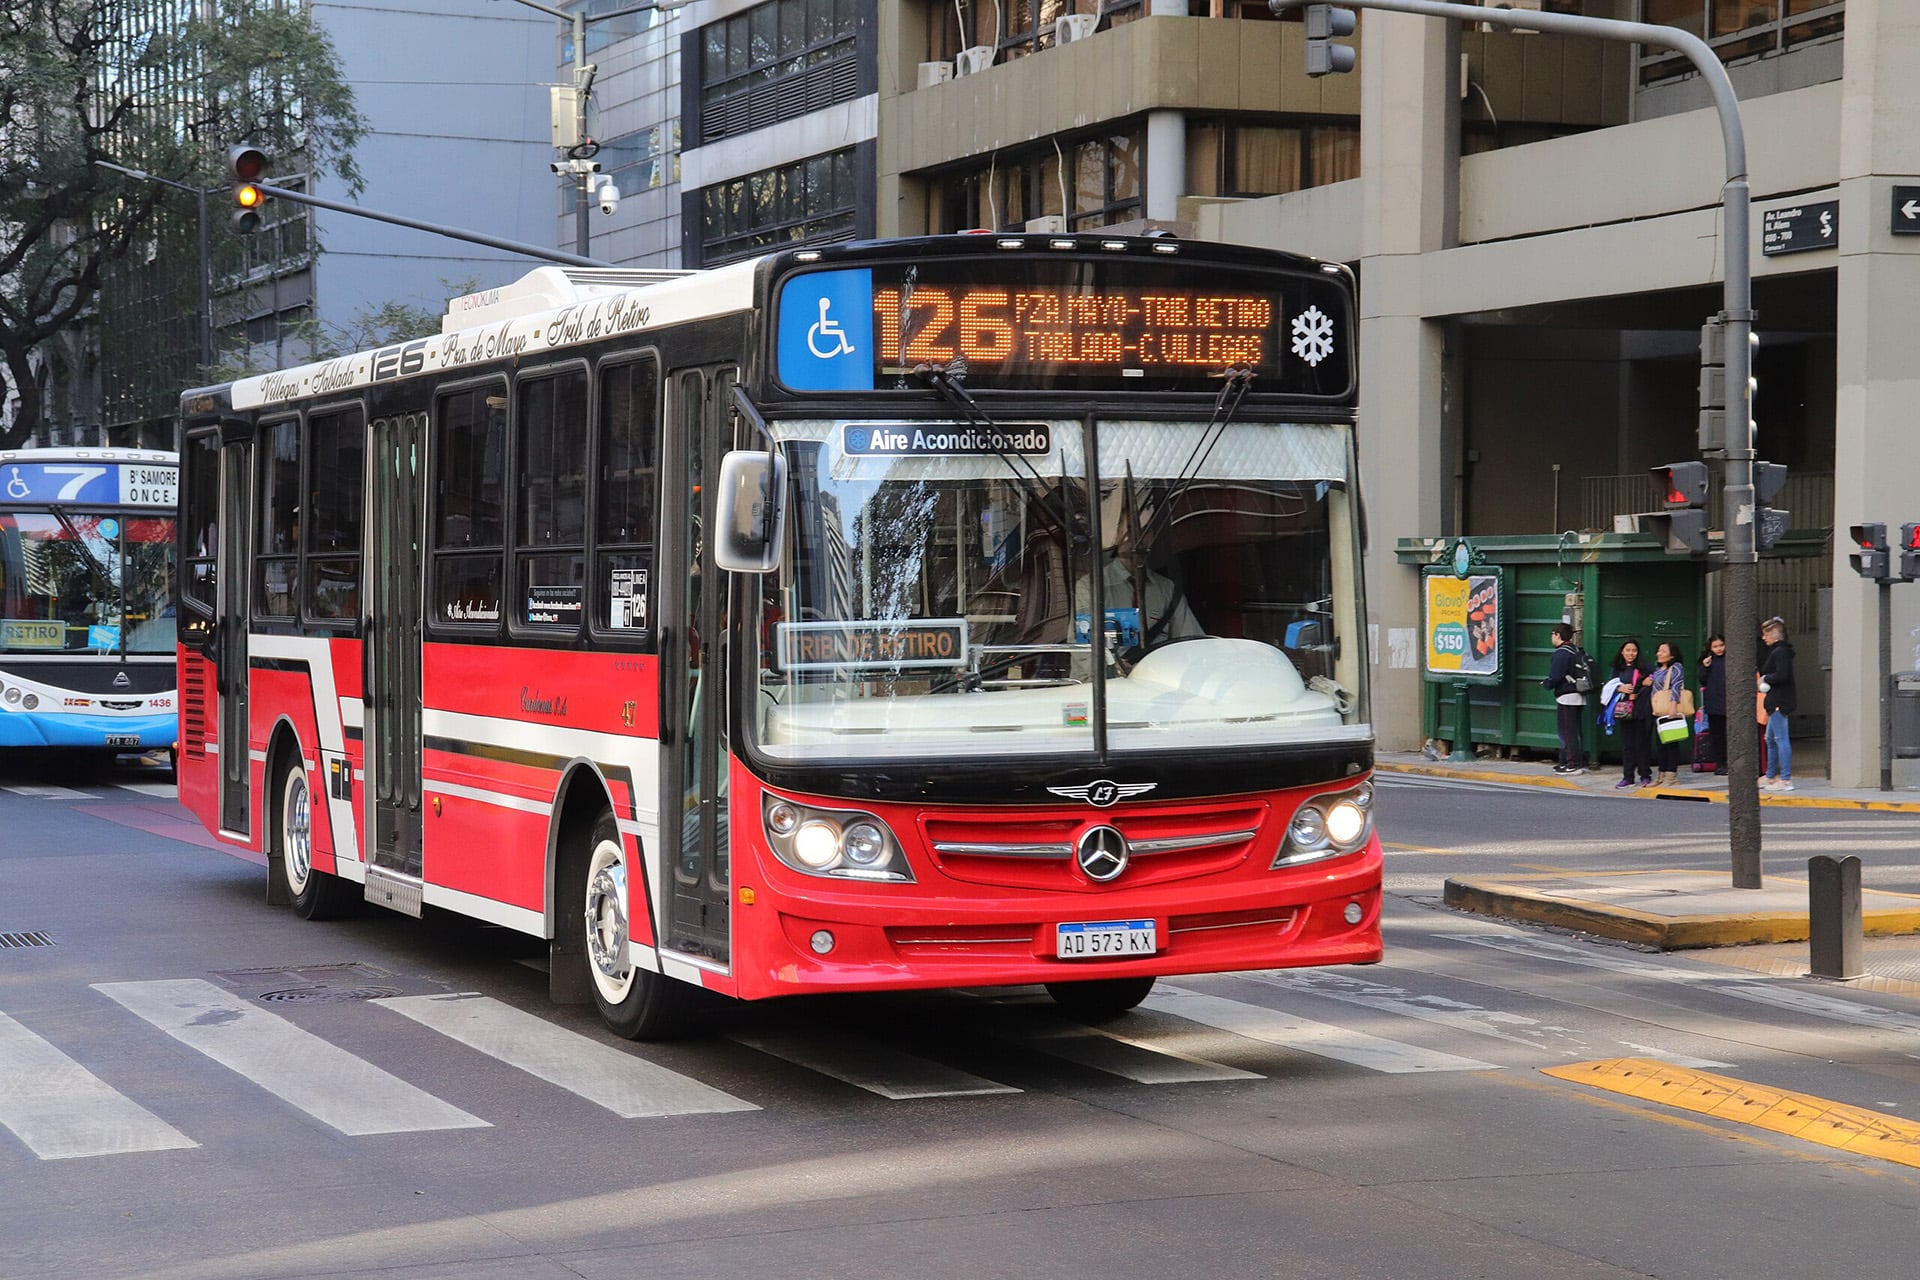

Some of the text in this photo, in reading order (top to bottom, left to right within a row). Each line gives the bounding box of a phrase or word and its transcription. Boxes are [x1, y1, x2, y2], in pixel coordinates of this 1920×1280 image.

[1777, 209, 1802, 219] Leandro
[1774, 221, 1790, 229] Alem
[874, 290, 1012, 359] 126
[260, 374, 300, 404] Villegas
[311, 359, 355, 394] Tablada
[370, 340, 429, 382] 126
[470, 329, 484, 361] de
[486, 320, 527, 368] Mayo
[547, 305, 589, 347] Trib
[587, 301, 601, 338] de
[605, 293, 651, 335] Retiro
[869, 429, 1047, 450] Aire Acondicionado
[43, 466, 107, 500] 7
[140, 471, 177, 486] SAMORE
[633, 593, 647, 618] 126
[1436, 593, 1462, 607] Glovo
[6, 625, 58, 640] RETIRO
[1437, 632, 1463, 651] $150
[879, 631, 953, 658] RETIRO
[148, 699, 172, 708] 1436
[622, 700, 636, 728] 47
[1064, 931, 1151, 954] AD 573 KX
